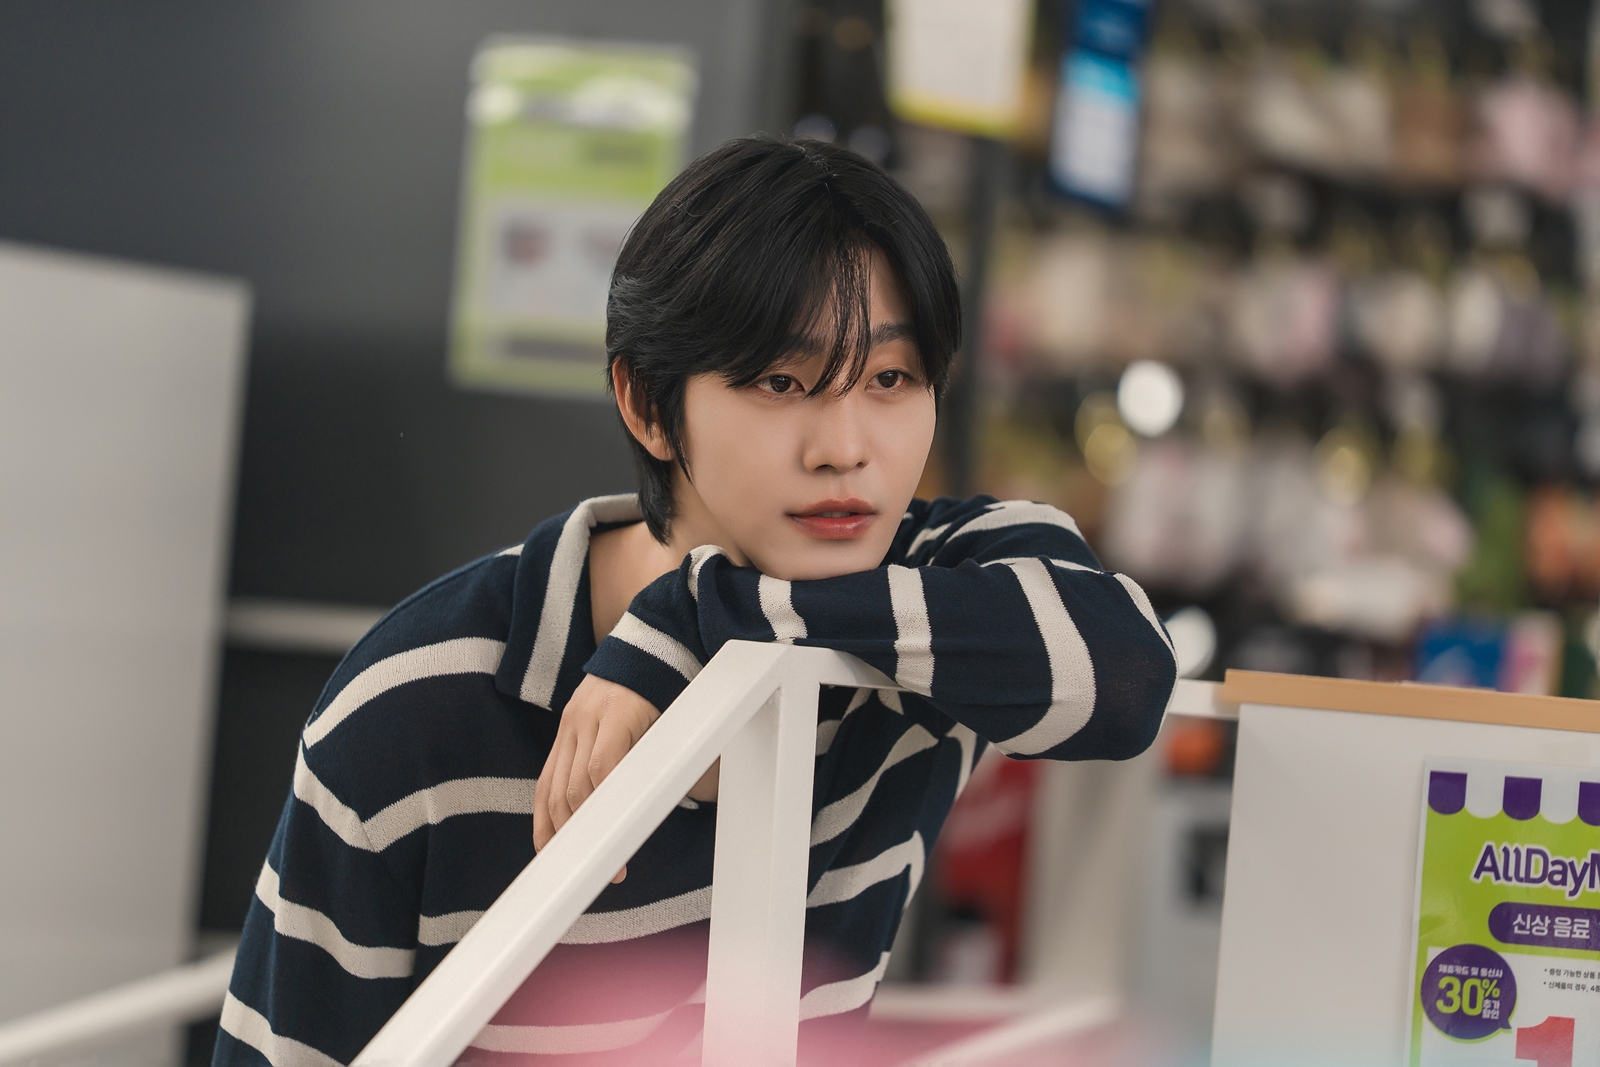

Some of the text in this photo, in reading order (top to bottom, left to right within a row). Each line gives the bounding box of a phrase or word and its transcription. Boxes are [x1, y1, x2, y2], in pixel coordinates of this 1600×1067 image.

[1512, 913, 1591, 940] 신상 음료
[1480, 967, 1503, 979] 통신사
[1563, 969, 1582, 978] 가능한
[1583, 971, 1595, 979] 상품
[1548, 981, 1573, 991] 신제품의
[1436, 975, 1501, 1016] 30%
[1483, 999, 1500, 1010] 추가
[1482, 1009, 1500, 1020] 할인
